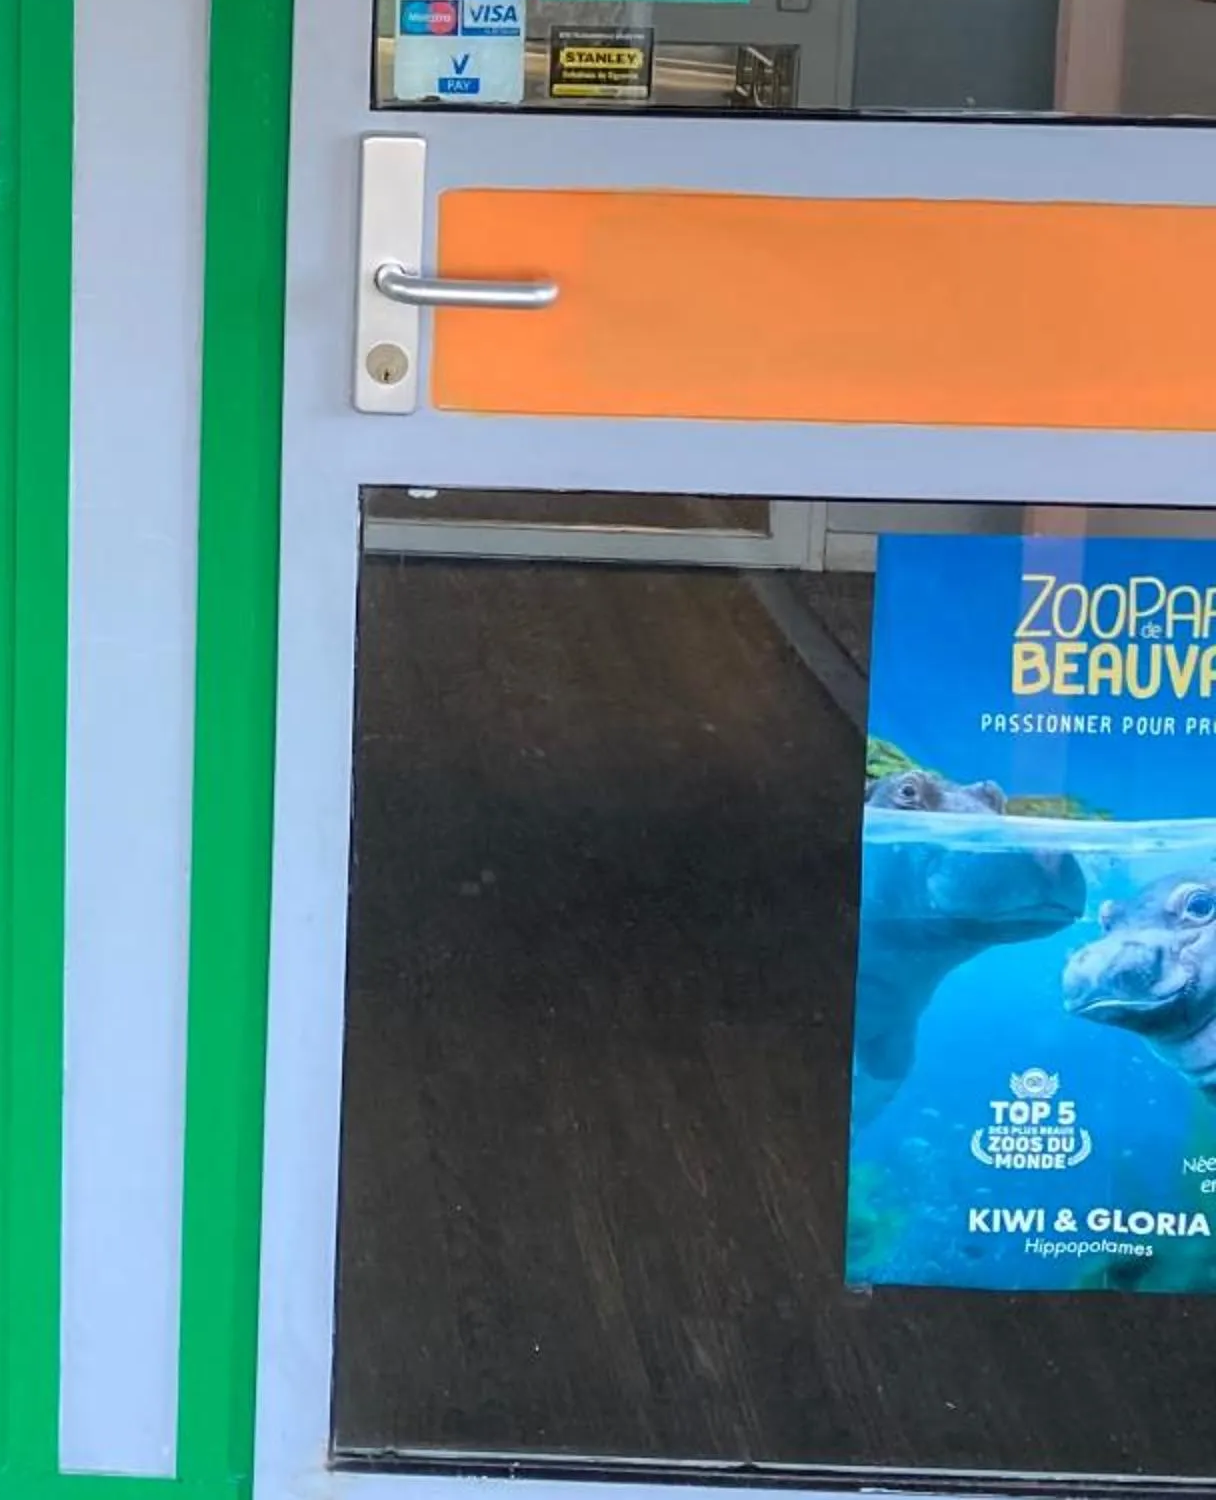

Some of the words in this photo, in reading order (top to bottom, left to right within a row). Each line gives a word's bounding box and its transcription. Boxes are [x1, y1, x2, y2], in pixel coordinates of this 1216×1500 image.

[469, 4, 518, 23] VISA
[451, 52, 470, 76] V
[566, 51, 637, 64] STANLEY
[447, 80, 471, 91] PAY
[980, 712, 1112, 736] PASSIONNER
[1121, 715, 1176, 737] POUR
[1185, 716, 1216, 737] PR
[989, 1100, 1052, 1126] TOP
[1057, 1100, 1077, 1126] 5
[987, 1135, 1044, 1154] ZOOS
[1046, 1135, 1076, 1154] DU
[994, 1153, 1067, 1170] MONDE
[968, 1208, 1045, 1234] KIWI
[1053, 1209, 1079, 1234] &
[1086, 1209, 1211, 1238] GLORIA
[1024, 1237, 1154, 1259] Hippopotames
